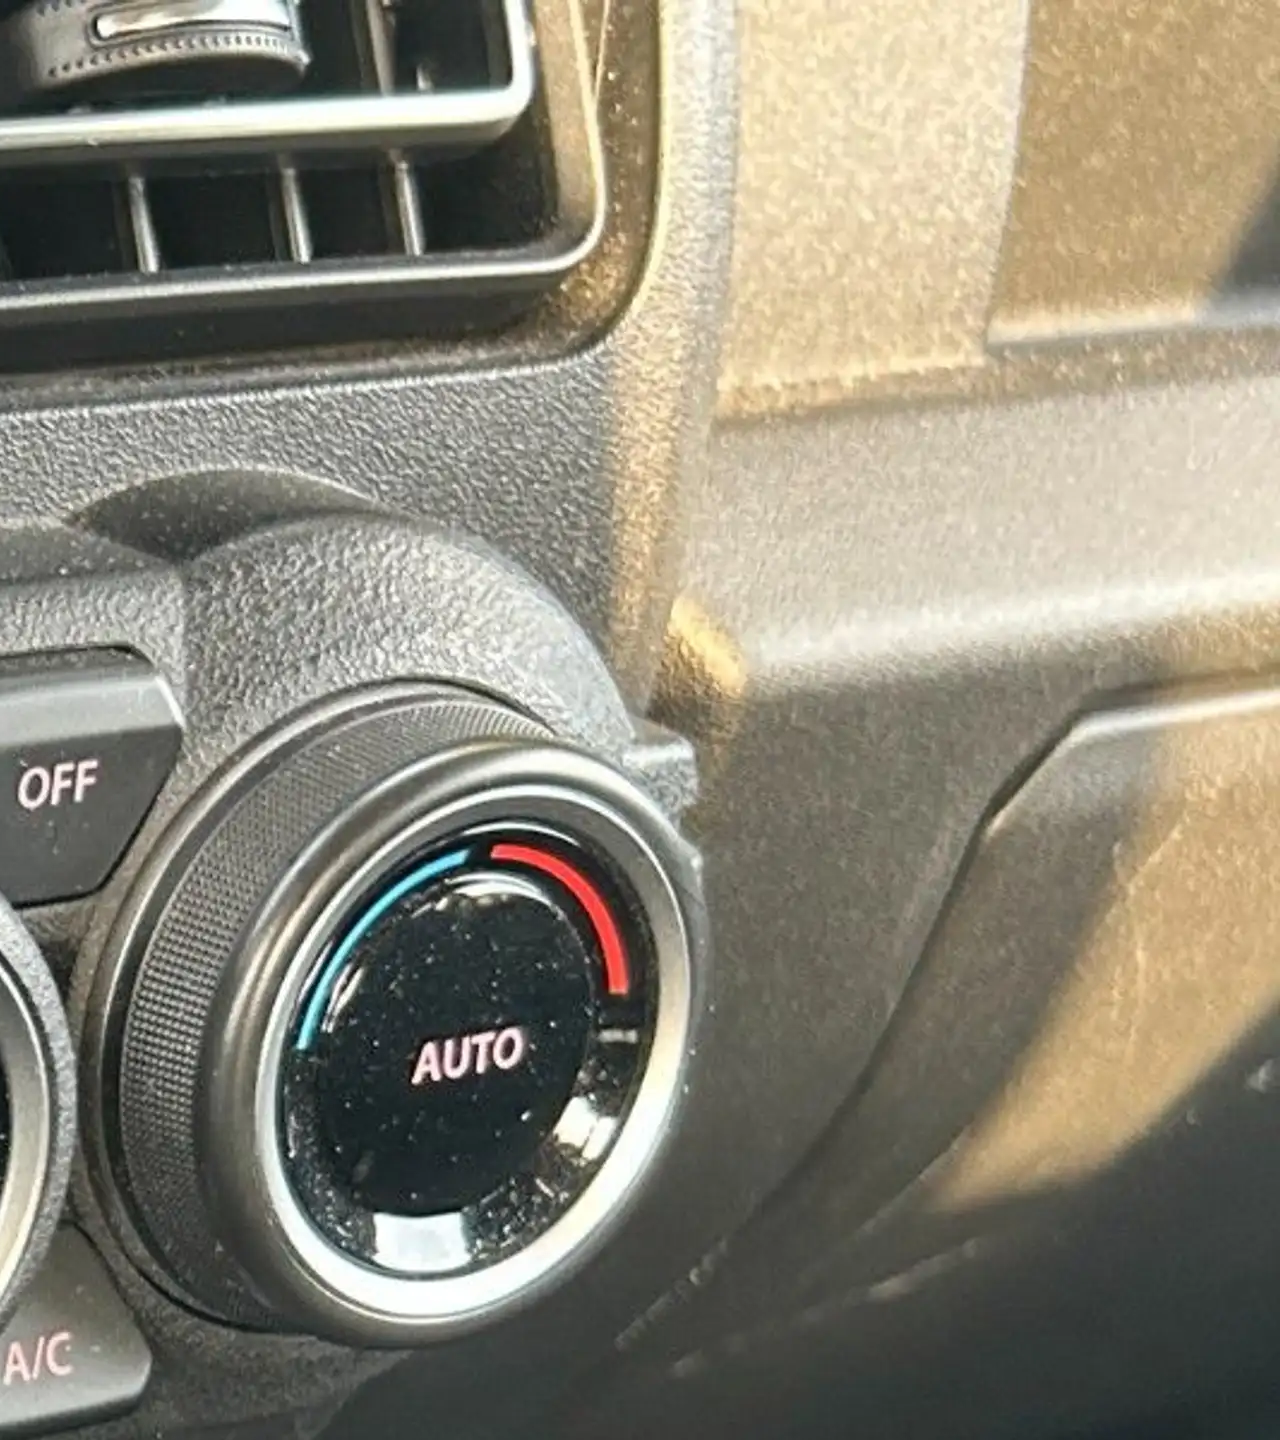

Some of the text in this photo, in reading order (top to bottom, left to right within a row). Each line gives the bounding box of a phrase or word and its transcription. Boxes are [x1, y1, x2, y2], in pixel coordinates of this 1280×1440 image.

[17, 759, 99, 811] OFF
[410, 1026, 526, 1086] AUTO
[2, 1330, 75, 1387] A/C
